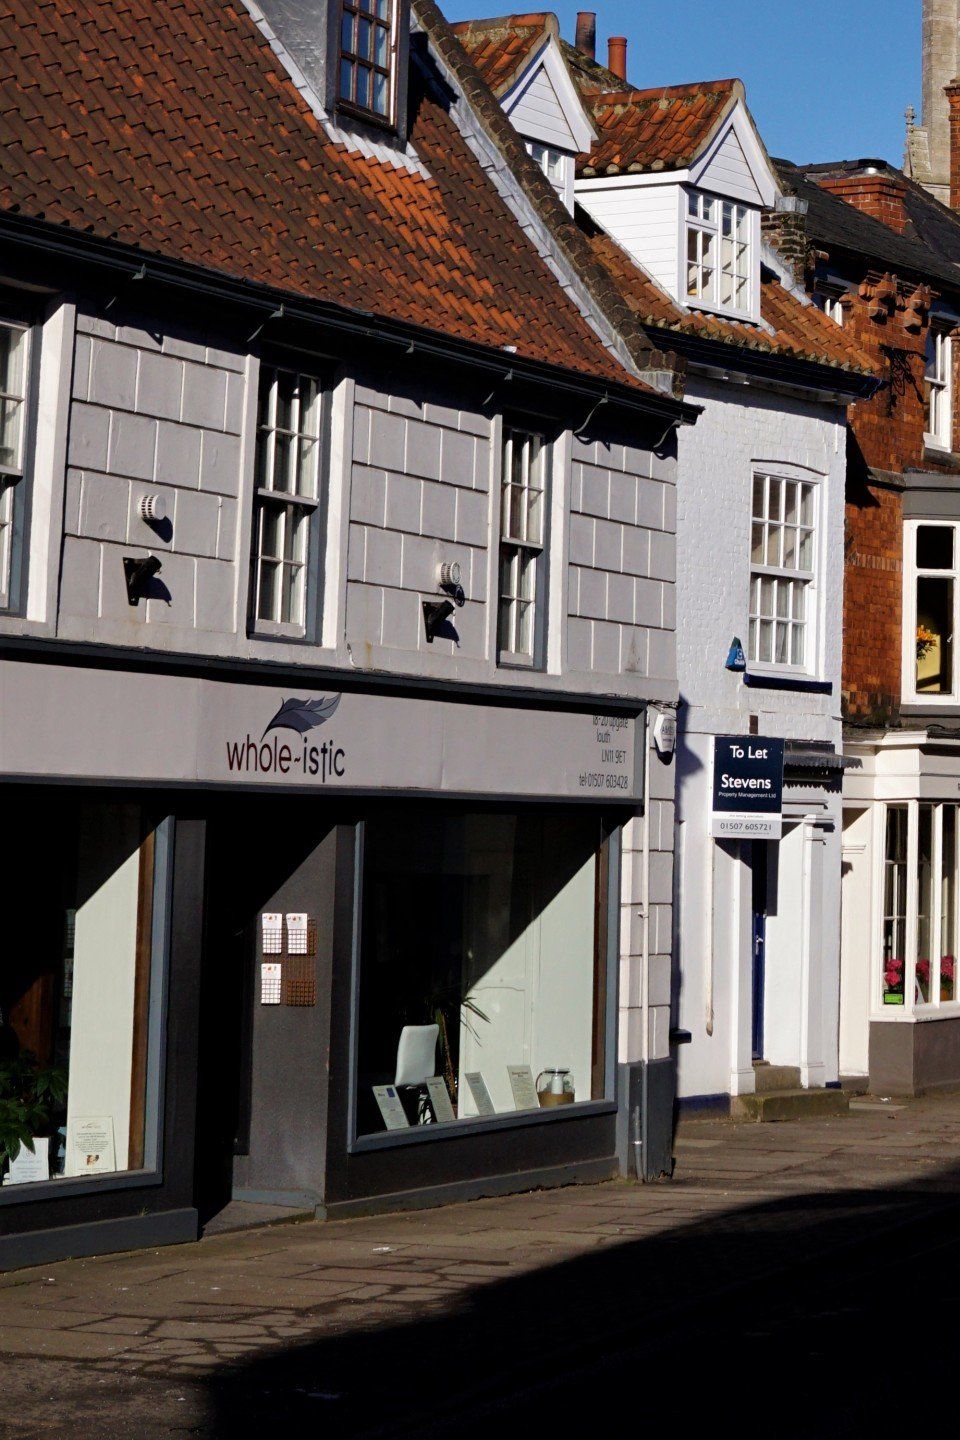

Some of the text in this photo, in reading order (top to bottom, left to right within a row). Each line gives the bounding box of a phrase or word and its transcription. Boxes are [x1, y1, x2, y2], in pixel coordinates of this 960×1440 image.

[729, 745, 768, 759] To Let
[721, 773, 771, 789] Stevens
[718, 791, 738, 799] Property
[738, 791, 768, 799] Management
[720, 822, 772, 831] 01507 605721
